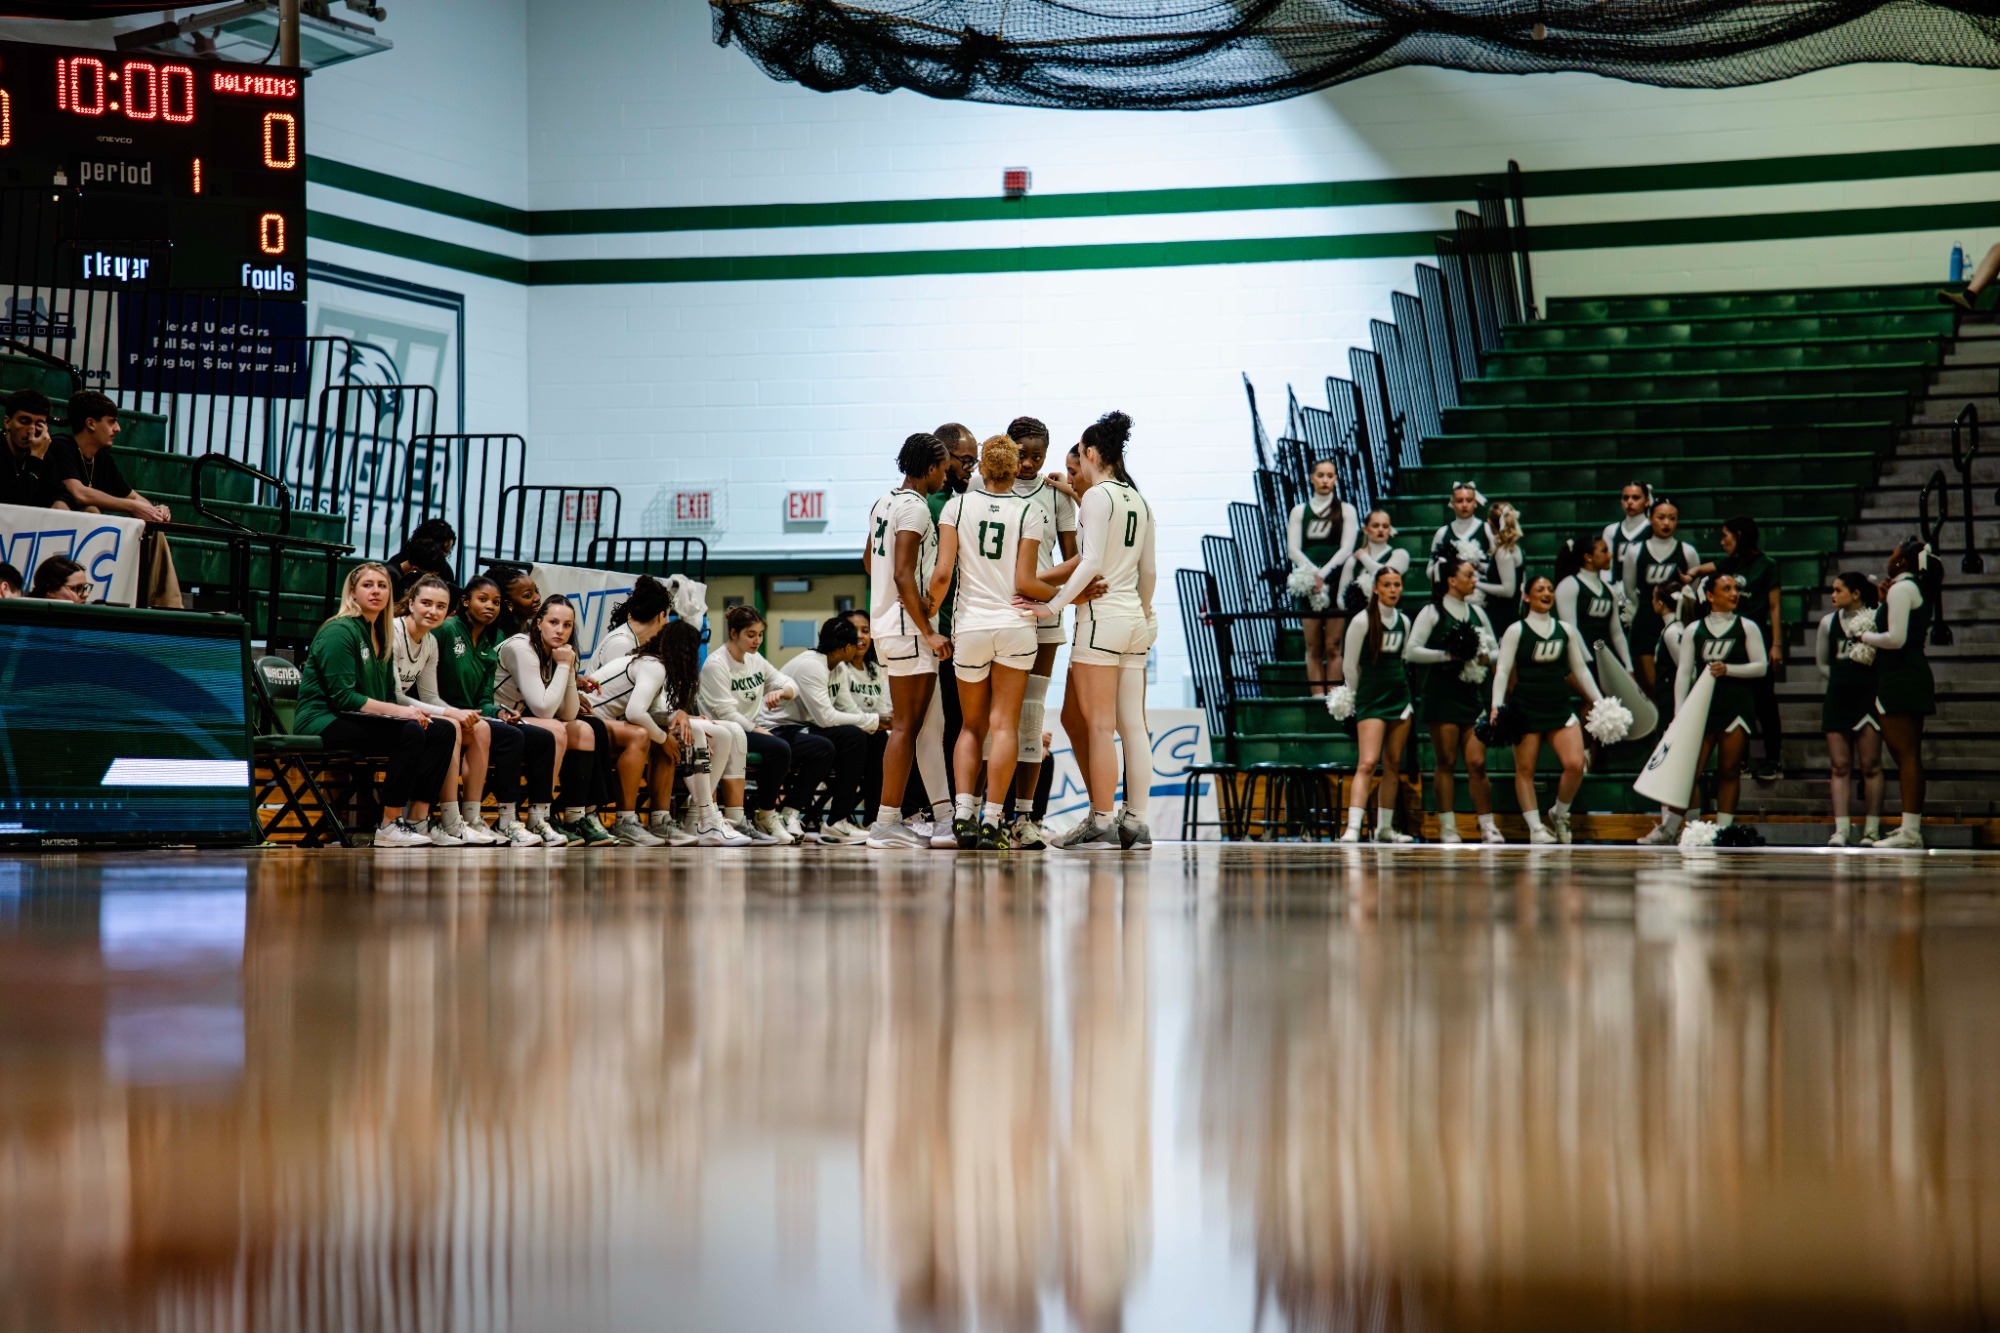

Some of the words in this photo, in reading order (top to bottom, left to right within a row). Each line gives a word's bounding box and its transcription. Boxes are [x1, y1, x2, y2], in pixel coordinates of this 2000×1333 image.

[57, 57, 194, 122] 10:00
[213, 72, 296, 97] DOLPHINS
[264, 112, 296, 169] 0
[80, 161, 152, 186] period
[193, 157, 201, 194] 1
[261, 213, 285, 254] 0
[84, 252, 149, 281] player
[242, 263, 295, 291] fouls
[204, 322, 236, 335] Ued
[180, 338, 228, 352] Sevie
[130, 353, 175, 370] Pyig
[203, 357, 213, 370] $
[565, 494, 598, 522] EIT
[676, 492, 710, 520] EXIT
[789, 491, 824, 519] EXIT
[978, 520, 1006, 560] 13
[1124, 510, 1138, 548] 0
[1645, 563, 1678, 585] W
[1586, 598, 1613, 619] W
[1531, 639, 1564, 662] W
[1702, 638, 1736, 662] W
